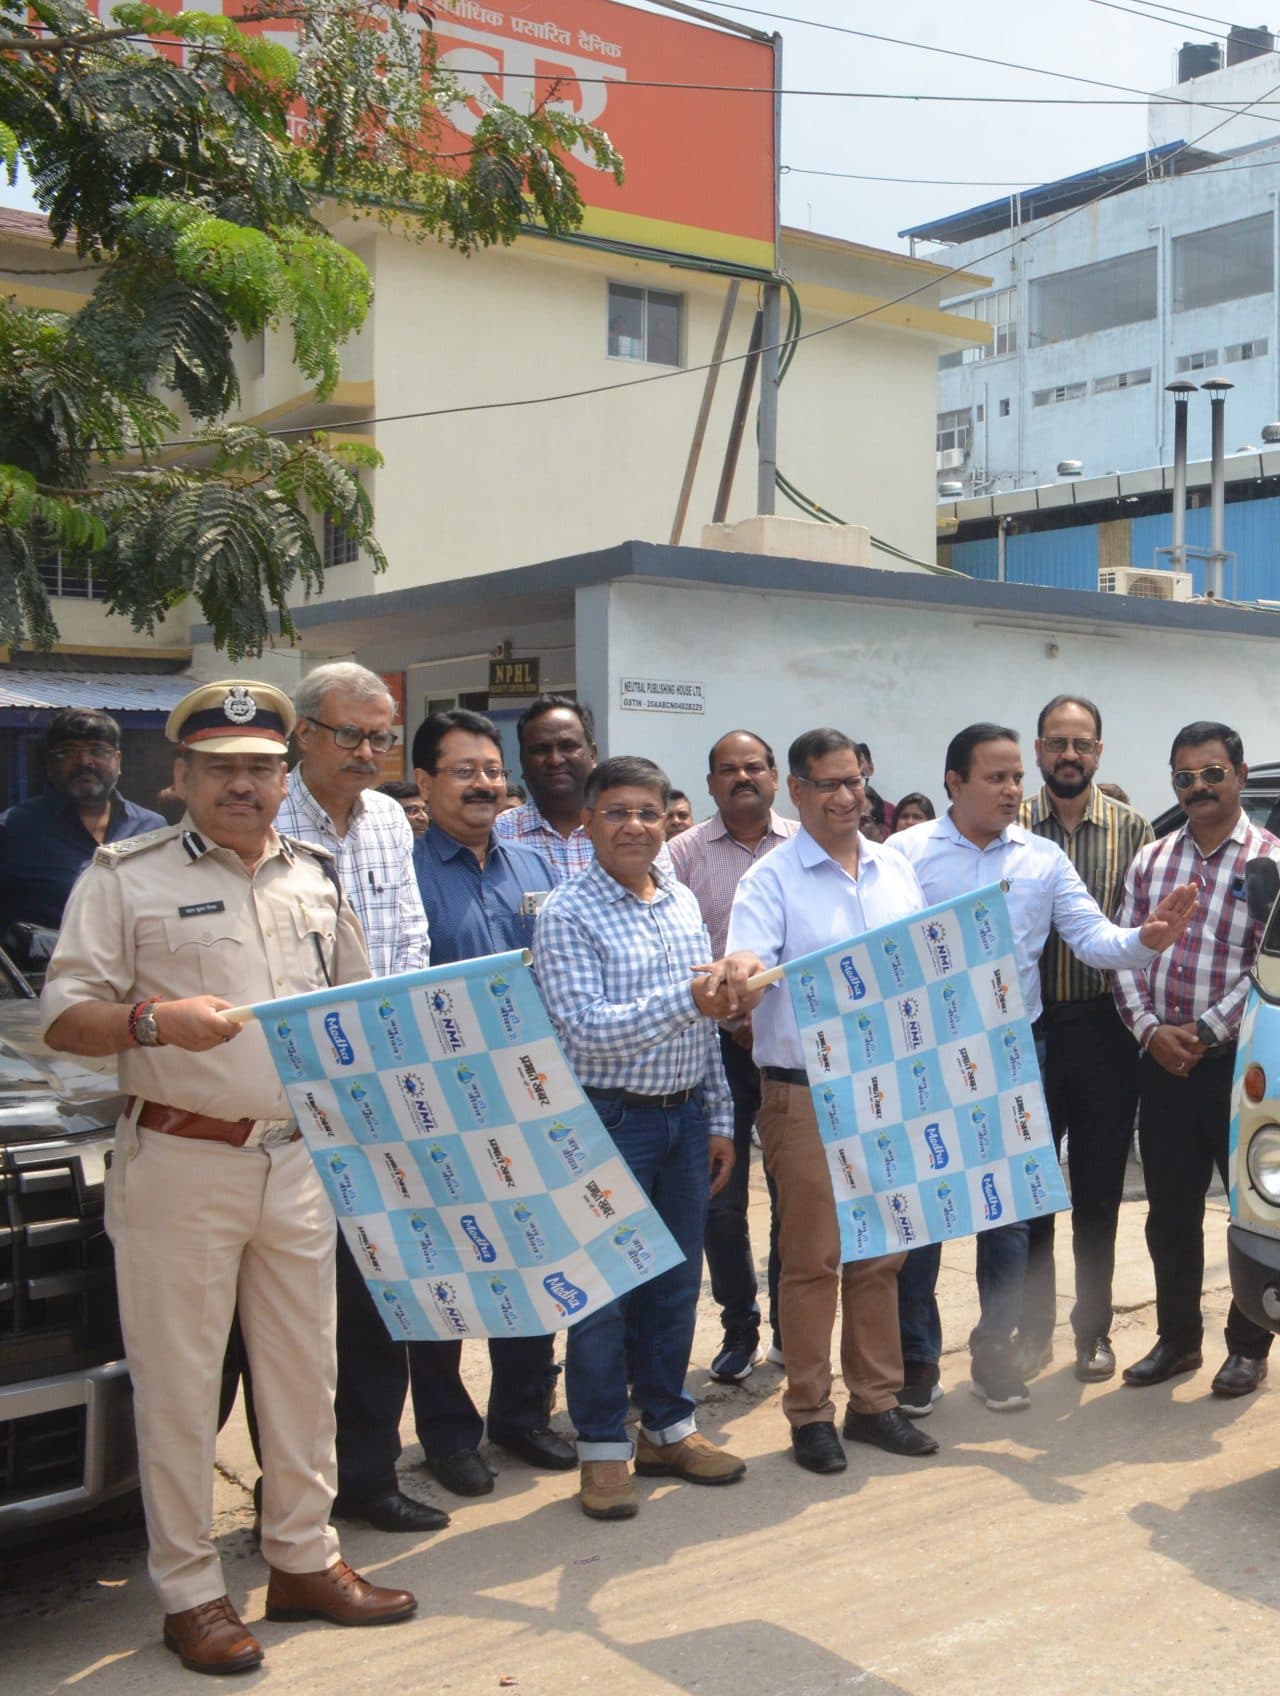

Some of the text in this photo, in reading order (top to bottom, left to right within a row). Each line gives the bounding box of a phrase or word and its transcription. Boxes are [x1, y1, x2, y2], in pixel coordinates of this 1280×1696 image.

[510, 16, 571, 46] प्रसारित
[577, 30, 622, 57] दैनिक
[496, 664, 532, 683] NPHL
[937, 945, 950, 975] NML
[842, 961, 862, 996] Medha
[327, 1017, 349, 1061] Medha
[443, 1018, 461, 1052] NML
[910, 1021, 921, 1049] NML
[415, 1100, 434, 1133] NML
[927, 1128, 944, 1165] Medha
[984, 1177, 998, 1216] Medha
[462, 1219, 491, 1259] Medha
[900, 1216, 912, 1245] NML
[547, 1277, 581, 1308] Medha
